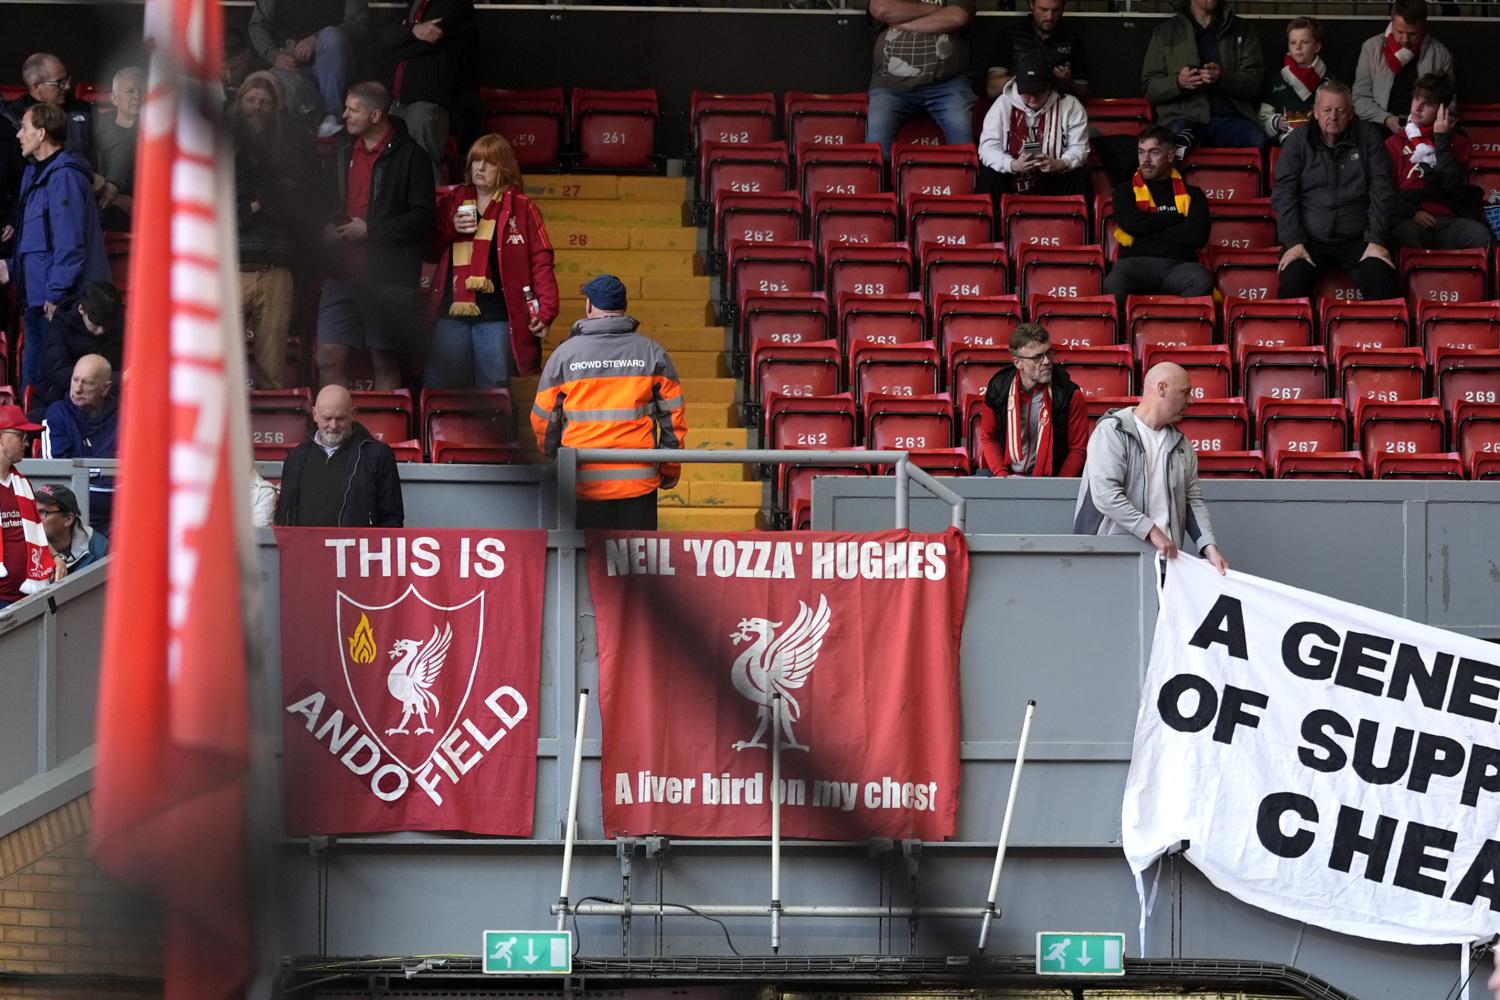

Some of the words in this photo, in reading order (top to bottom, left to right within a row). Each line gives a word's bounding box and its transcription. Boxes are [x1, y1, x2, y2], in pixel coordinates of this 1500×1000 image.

[603, 132, 625, 144] 261
[721, 132, 749, 144] 262
[815, 135, 844, 145] 263
[562, 185, 581, 197] 27
[732, 182, 760, 193] 262
[923, 186, 951, 196] 264
[1206, 189, 1235, 200] 267
[506, 234, 525, 244] AXA
[569, 235, 588, 246] 26
[745, 231, 774, 242] 262
[937, 236, 966, 247] 264
[1031, 237, 1060, 247] 265
[1221, 240, 1250, 249] 267
[855, 284, 885, 295] 263
[951, 285, 980, 296] 264
[1049, 287, 1078, 298] 265
[1240, 288, 1268, 301] 267
[1430, 291, 1459, 302] 269
[772, 334, 802, 344] 262
[867, 336, 897, 345] 263
[964, 336, 993, 347] 264
[570, 360, 602, 372] CROWD
[602, 359, 645, 370] STEWARD
[354, 380, 373, 391] 57
[1272, 388, 1301, 400] 267
[1368, 391, 1398, 403] 268
[1466, 392, 1496, 403] 269
[254, 432, 284, 444] 256
[798, 433, 827, 445] 262
[896, 437, 926, 449] 263
[1192, 439, 1221, 450] 266
[1289, 441, 1318, 453] 267
[1386, 442, 1417, 454] 268
[325, 538, 442, 578] THIS
[460, 537, 506, 578] IS
[606, 538, 675, 577] NEIL
[684, 539, 803, 579] 'YOZZA'
[811, 541, 947, 582] HUGHES
[1188, 594, 1249, 661] A
[1157, 673, 1269, 745] OF
[285, 691, 409, 803] ANDO
[415, 684, 528, 807] FIELD
[615, 772, 634, 805] A
[638, 770, 696, 804] liver
[702, 773, 764, 806] bird
[770, 778, 805, 806] on
[812, 780, 858, 812] my
[864, 777, 936, 812] chest
